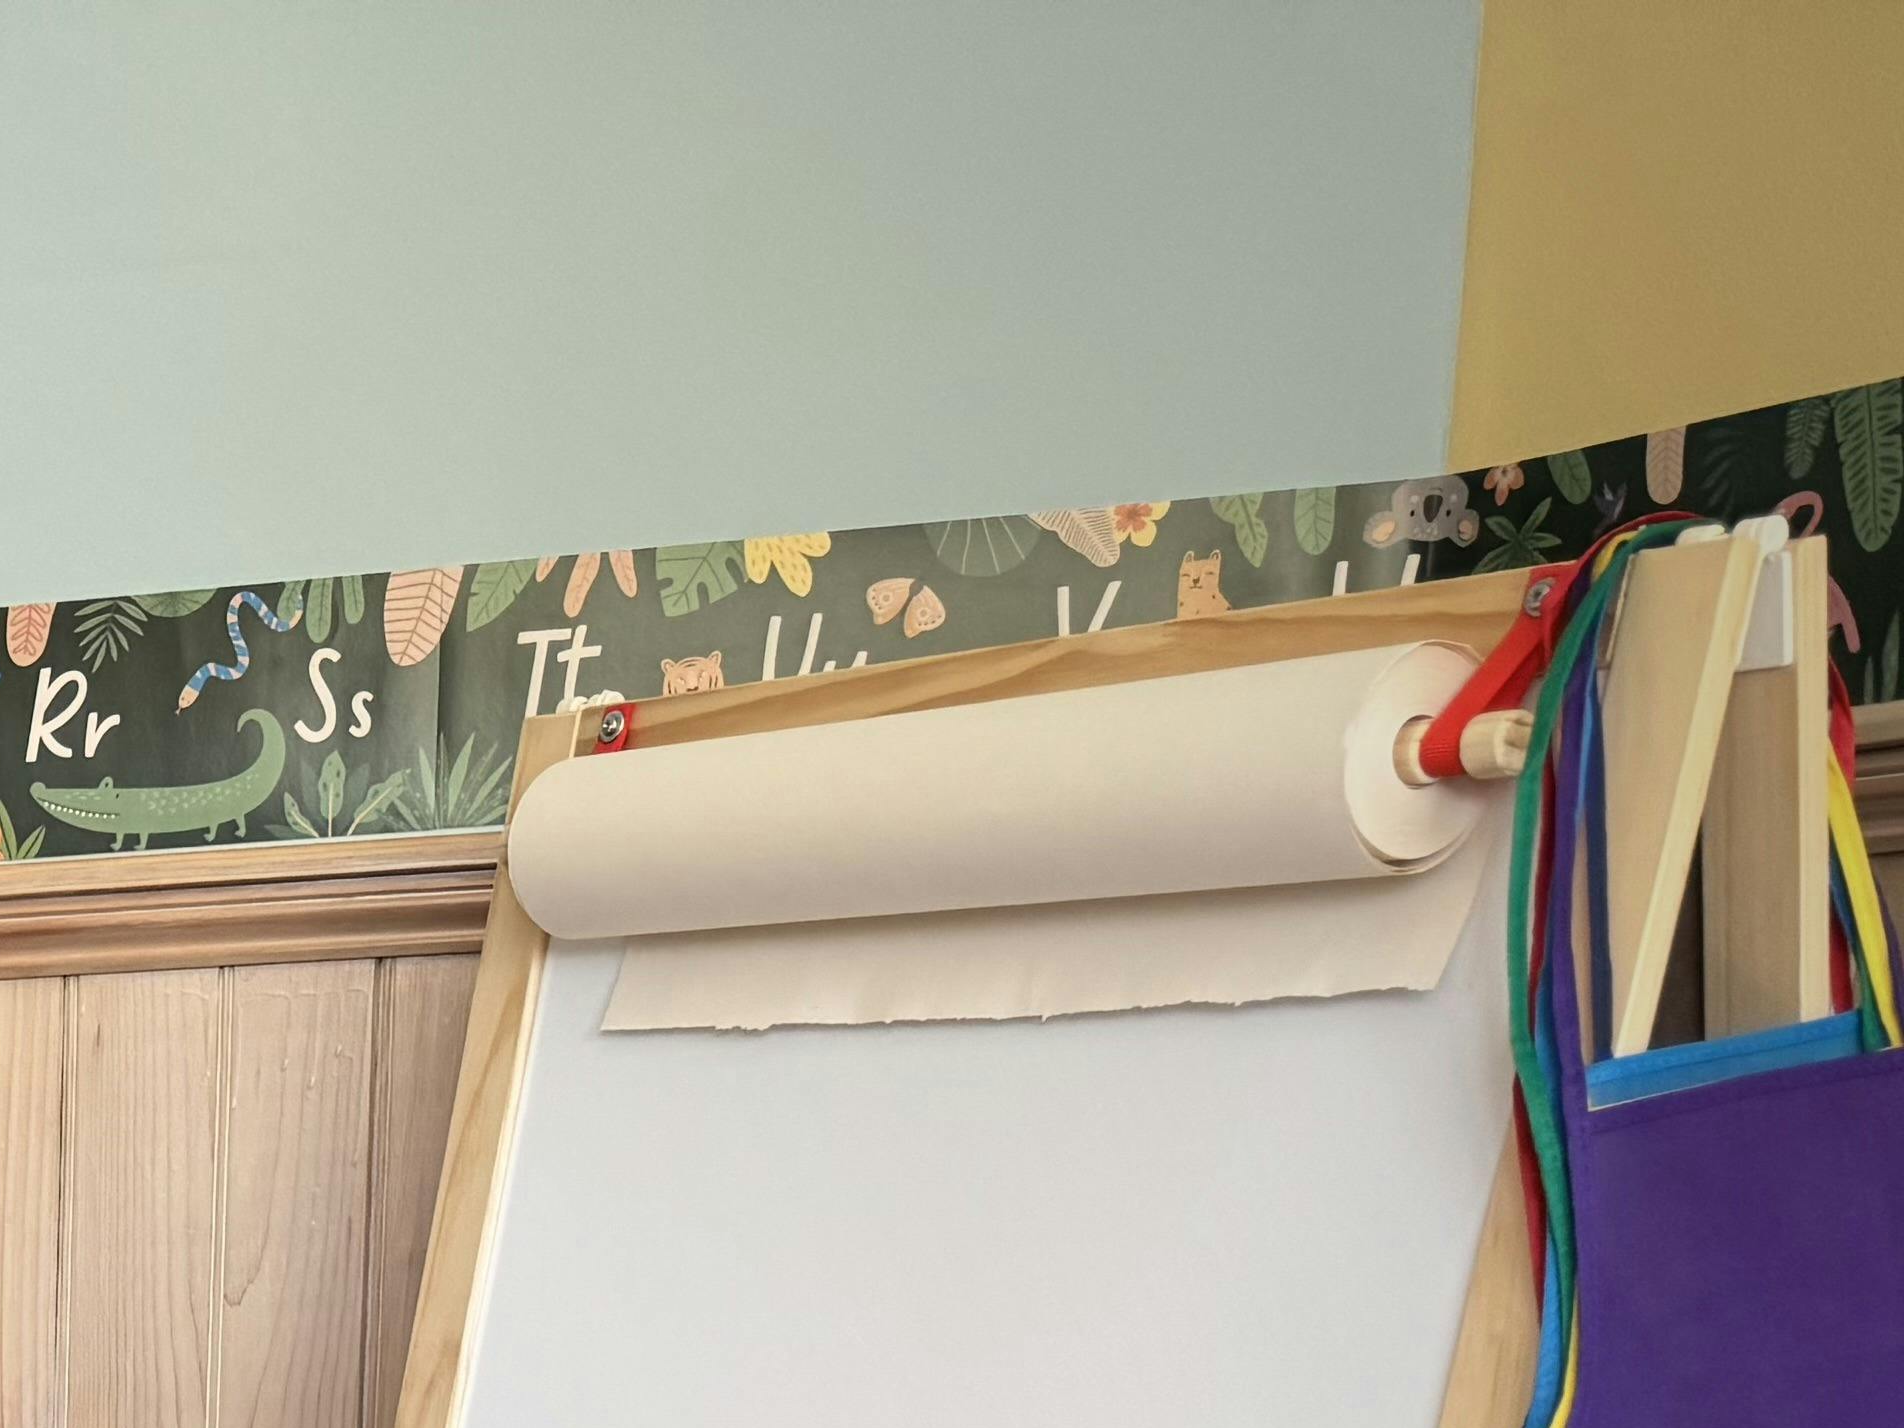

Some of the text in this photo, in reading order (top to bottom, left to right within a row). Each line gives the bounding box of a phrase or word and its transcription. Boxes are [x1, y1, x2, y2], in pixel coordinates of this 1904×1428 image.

[26, 667, 120, 762] Rr
[295, 648, 374, 744] Ss
[517, 625, 602, 718] Tt
